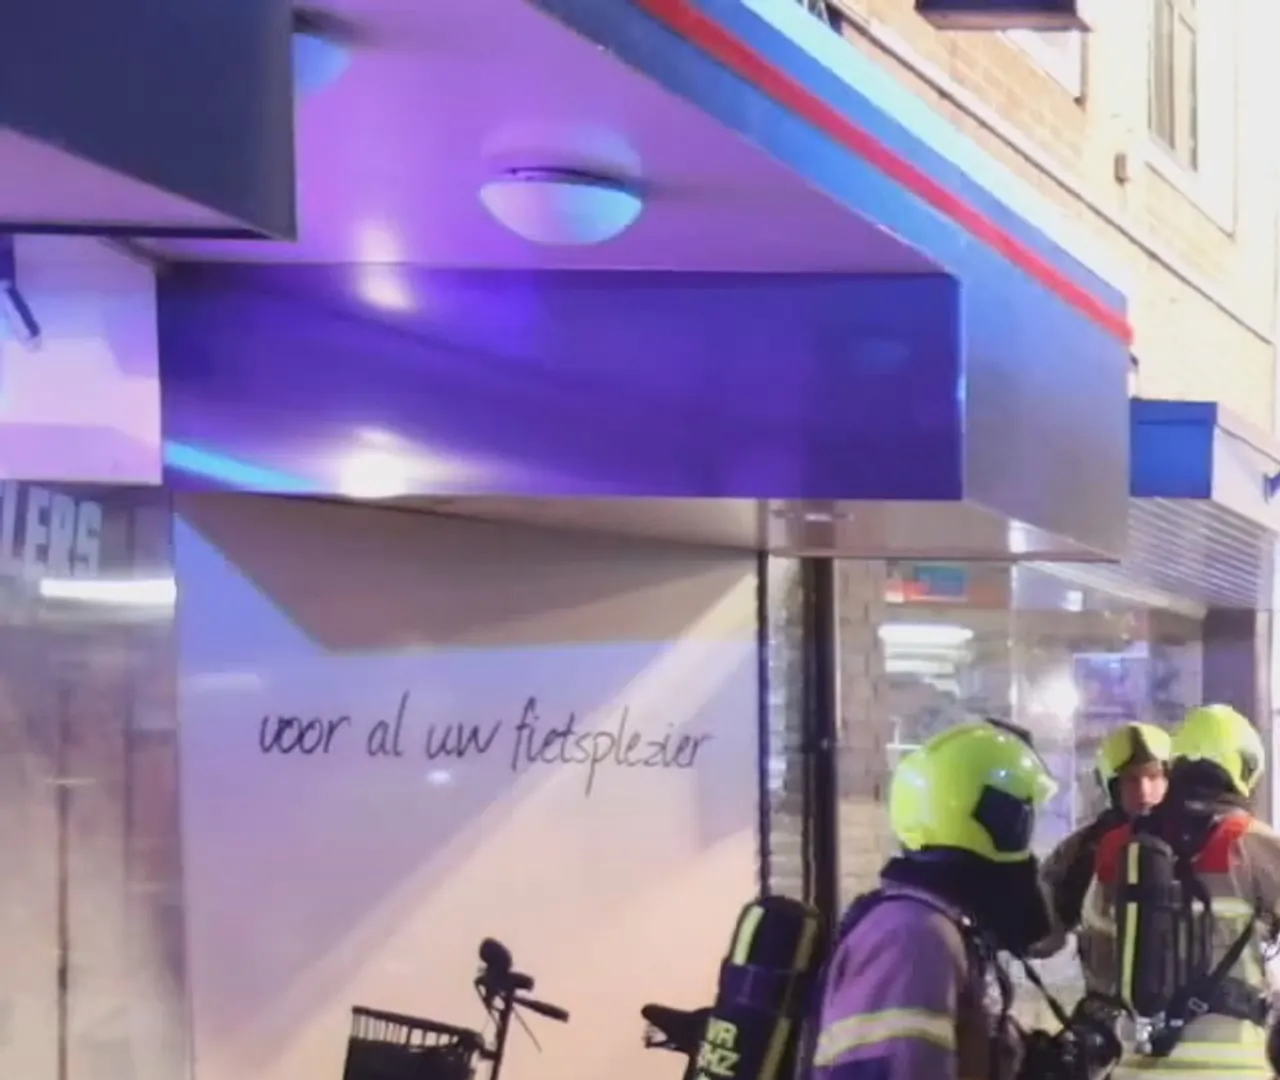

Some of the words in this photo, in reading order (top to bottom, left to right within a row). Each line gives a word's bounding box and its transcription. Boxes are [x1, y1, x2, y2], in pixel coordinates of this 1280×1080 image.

[260, 715, 351, 756] voor
[366, 690, 410, 758] al
[425, 719, 502, 760] uw
[512, 696, 716, 799] fietsplezier
